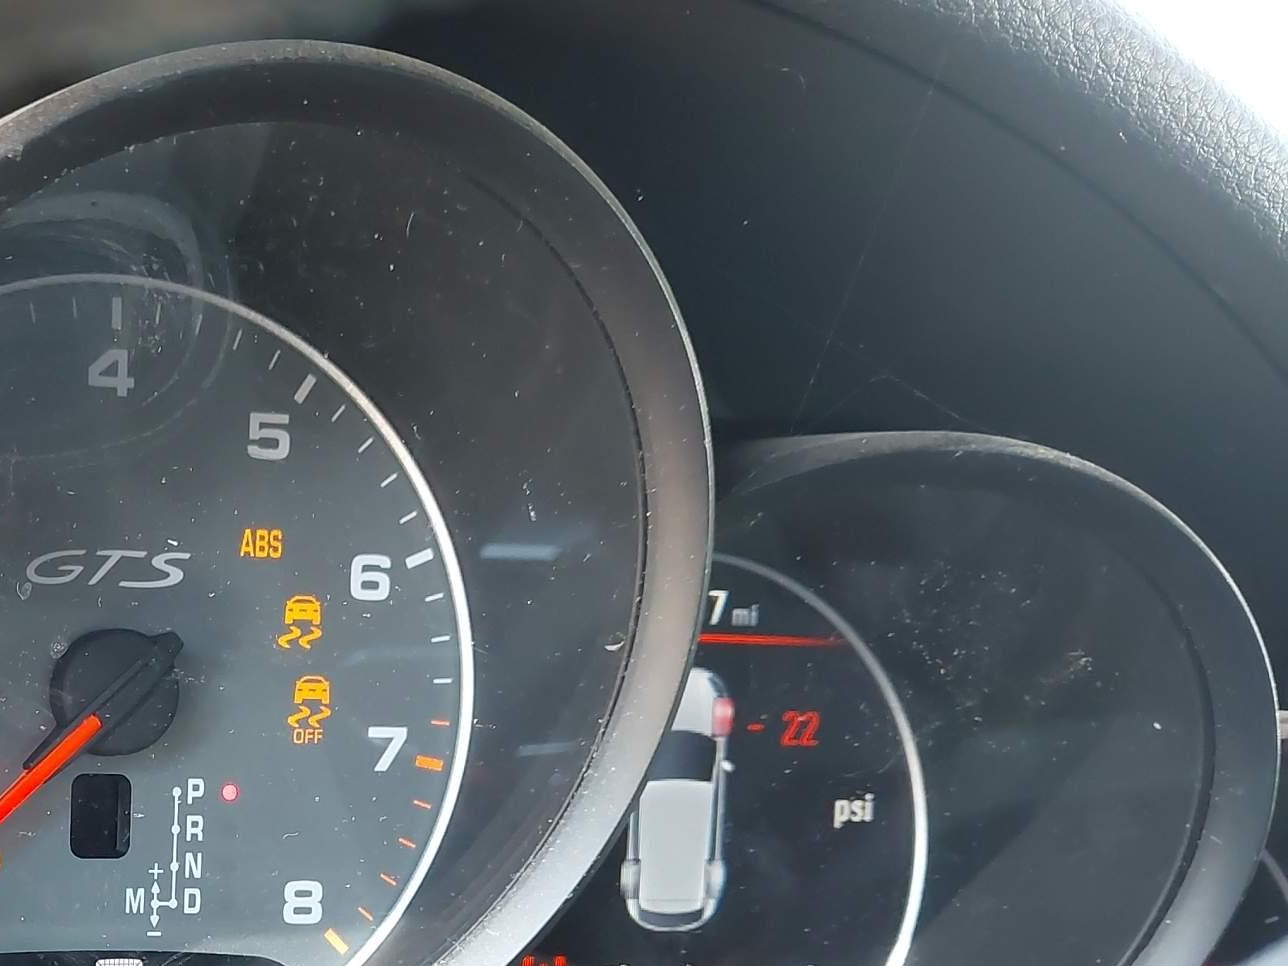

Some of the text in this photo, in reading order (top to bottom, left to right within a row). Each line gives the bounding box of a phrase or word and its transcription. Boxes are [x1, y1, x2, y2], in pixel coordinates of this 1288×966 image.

[88, 349, 135, 397] 4
[247, 412, 291, 460] 5
[240, 529, 283, 558] ABS
[25, 549, 192, 588] GTS
[350, 554, 392, 601] 6
[708, 590, 760, 626] 7 mi
[293, 728, 324, 744] OFF
[780, 710, 820, 746] 22
[367, 726, 408, 772] 7
[187, 778, 205, 804] P
[186, 815, 204, 841] R
[833, 793, 875, 829] psi
[185, 852, 202, 879] N
[125, 887, 145, 914] M
[184, 887, 202, 914] D
[283, 880, 323, 924] 8
